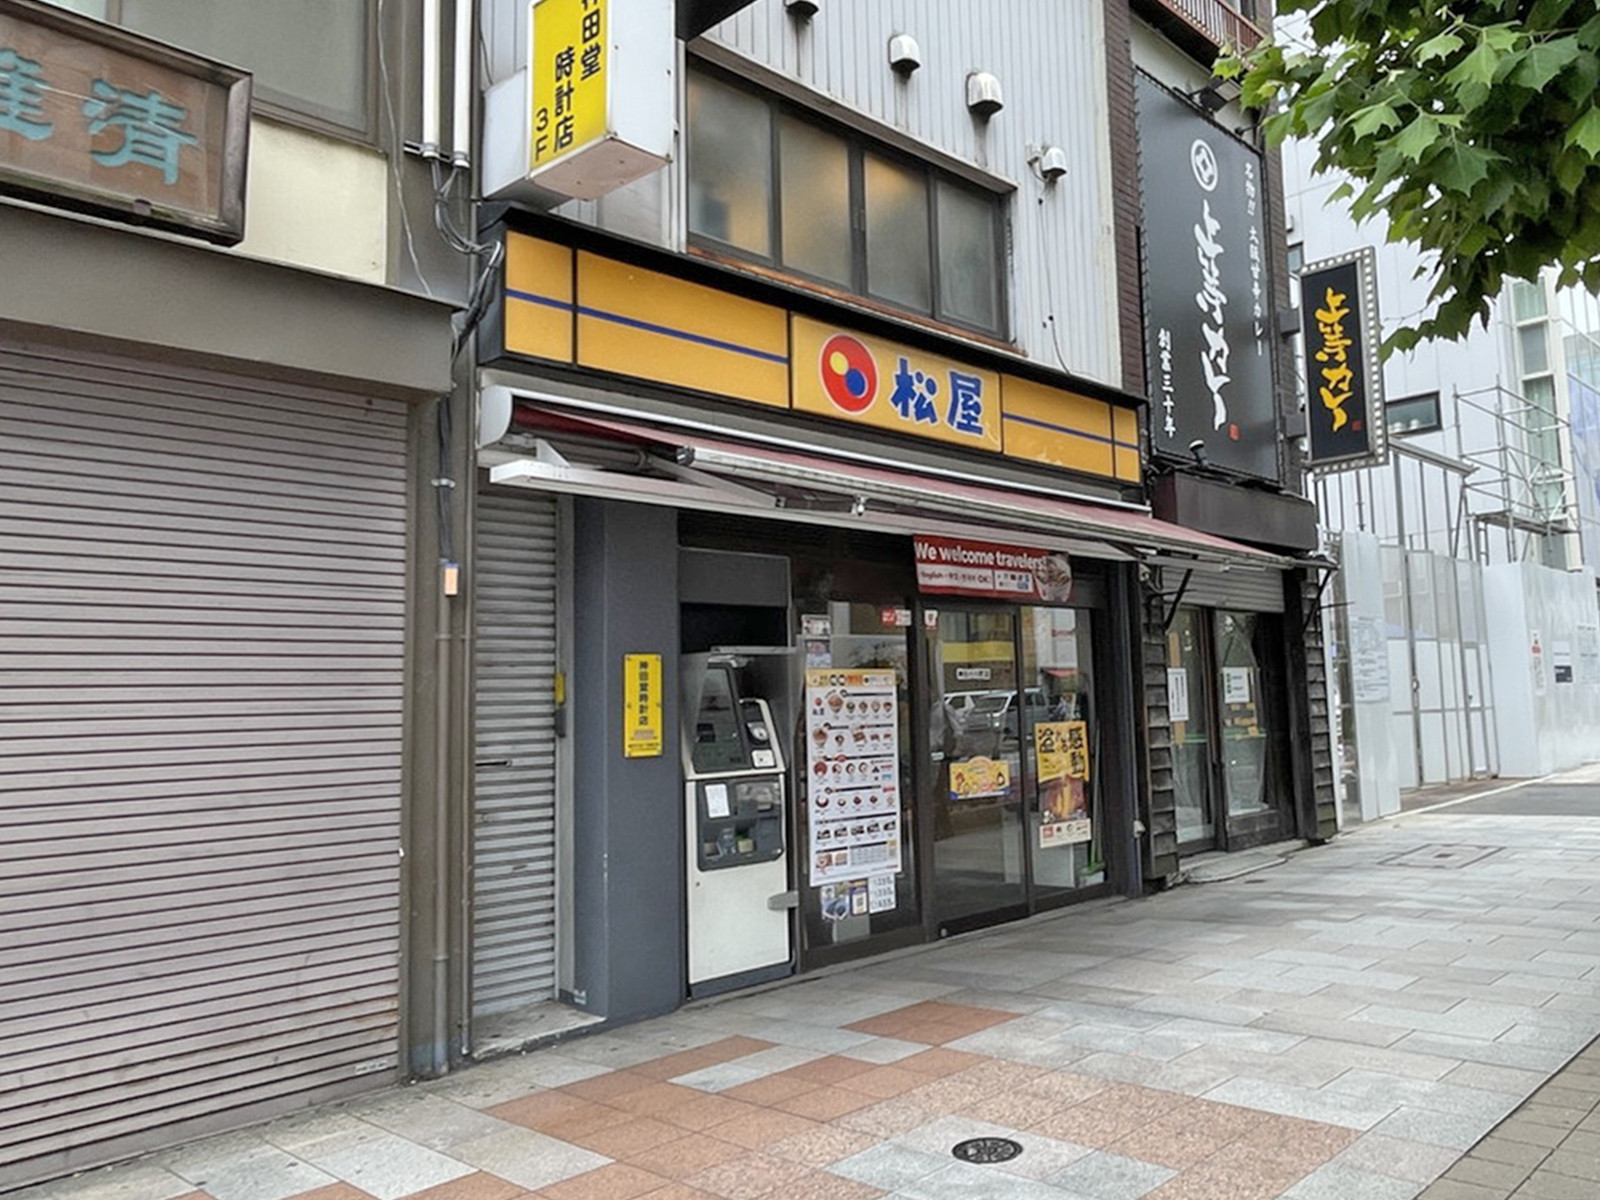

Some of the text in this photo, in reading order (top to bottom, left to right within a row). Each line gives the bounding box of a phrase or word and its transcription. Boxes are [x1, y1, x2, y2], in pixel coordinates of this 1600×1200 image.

[580, 0, 601, 82] 田堂
[535, 107, 549, 162] 3F
[554, 46, 575, 153] 時計店
[1193, 199, 1231, 431] 上等カレー
[888, 356, 985, 438] 松屋
[1315, 287, 1353, 432] 上等カレー
[914, 541, 937, 560] We
[937, 545, 995, 565] welcome
